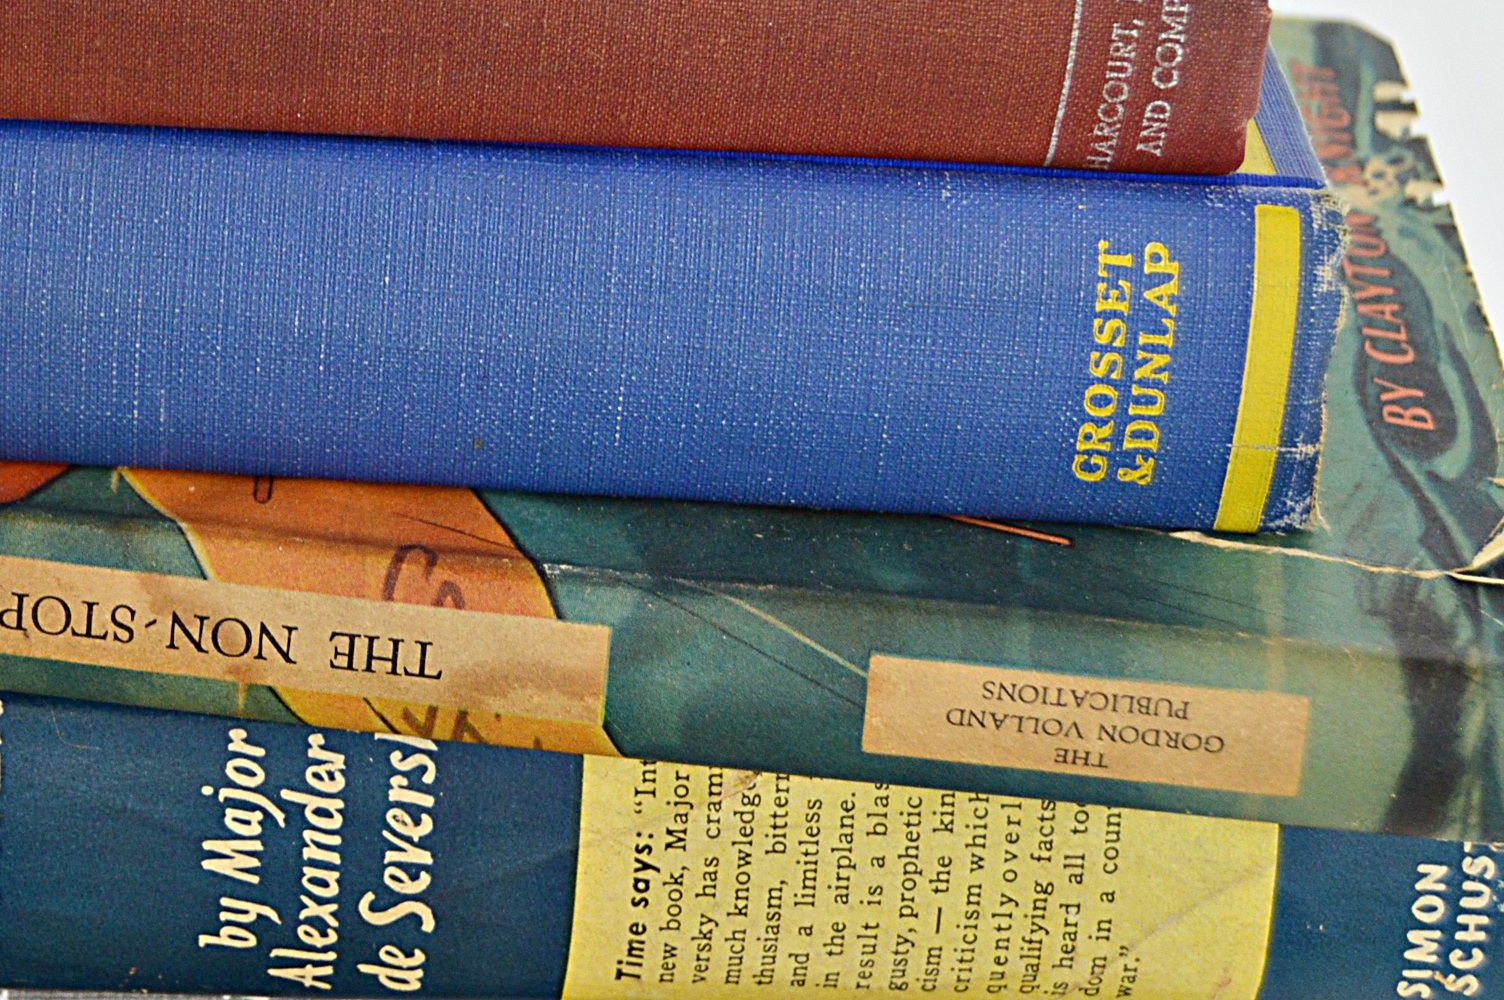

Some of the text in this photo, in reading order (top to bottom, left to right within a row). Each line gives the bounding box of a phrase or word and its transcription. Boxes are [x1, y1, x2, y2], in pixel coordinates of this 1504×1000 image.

[1087, 18, 1145, 170] HARCOURT,
[1136, 99, 1172, 157] AND
[1072, 239, 1134, 483] GROSSET
[1381, 371, 1434, 432] BY
[329, 630, 443, 680] THE
[946, 708, 1226, 755] GORDON VOLLAND
[982, 680, 1191, 721] PUBLICATIONS
[1053, 746, 1109, 769] THE
[201, 728, 285, 884] Major
[267, 733, 346, 991] Alexander
[630, 831, 661, 909] says:
[658, 770, 694, 984] new book, Major
[691, 766, 724, 984] versky has cram
[794, 798, 823, 908] limitless
[870, 855, 886, 869] a
[928, 854, 953, 895] the
[198, 897, 281, 949] by
[814, 791, 857, 989] in the airplane.
[859, 883, 884, 907] is
[888, 795, 924, 992] gusty, prophetic
[986, 801, 1023, 995] quently overl
[1018, 799, 1057, 995] qualifying facts
[1043, 801, 1091, 998] is heard all to
[1078, 807, 1123, 998] dom in a coun
[614, 921, 647, 982] Time
[724, 928, 747, 986] much
[752, 879, 789, 987] thusiasm,
[798, 924, 813, 937] a
[855, 921, 880, 990] result
[953, 883, 983, 994] criticism
[1396, 863, 1451, 999] SIMON
[357, 943, 426, 992] de
[788, 952, 810, 987] and
[914, 945, 943, 993] cism
